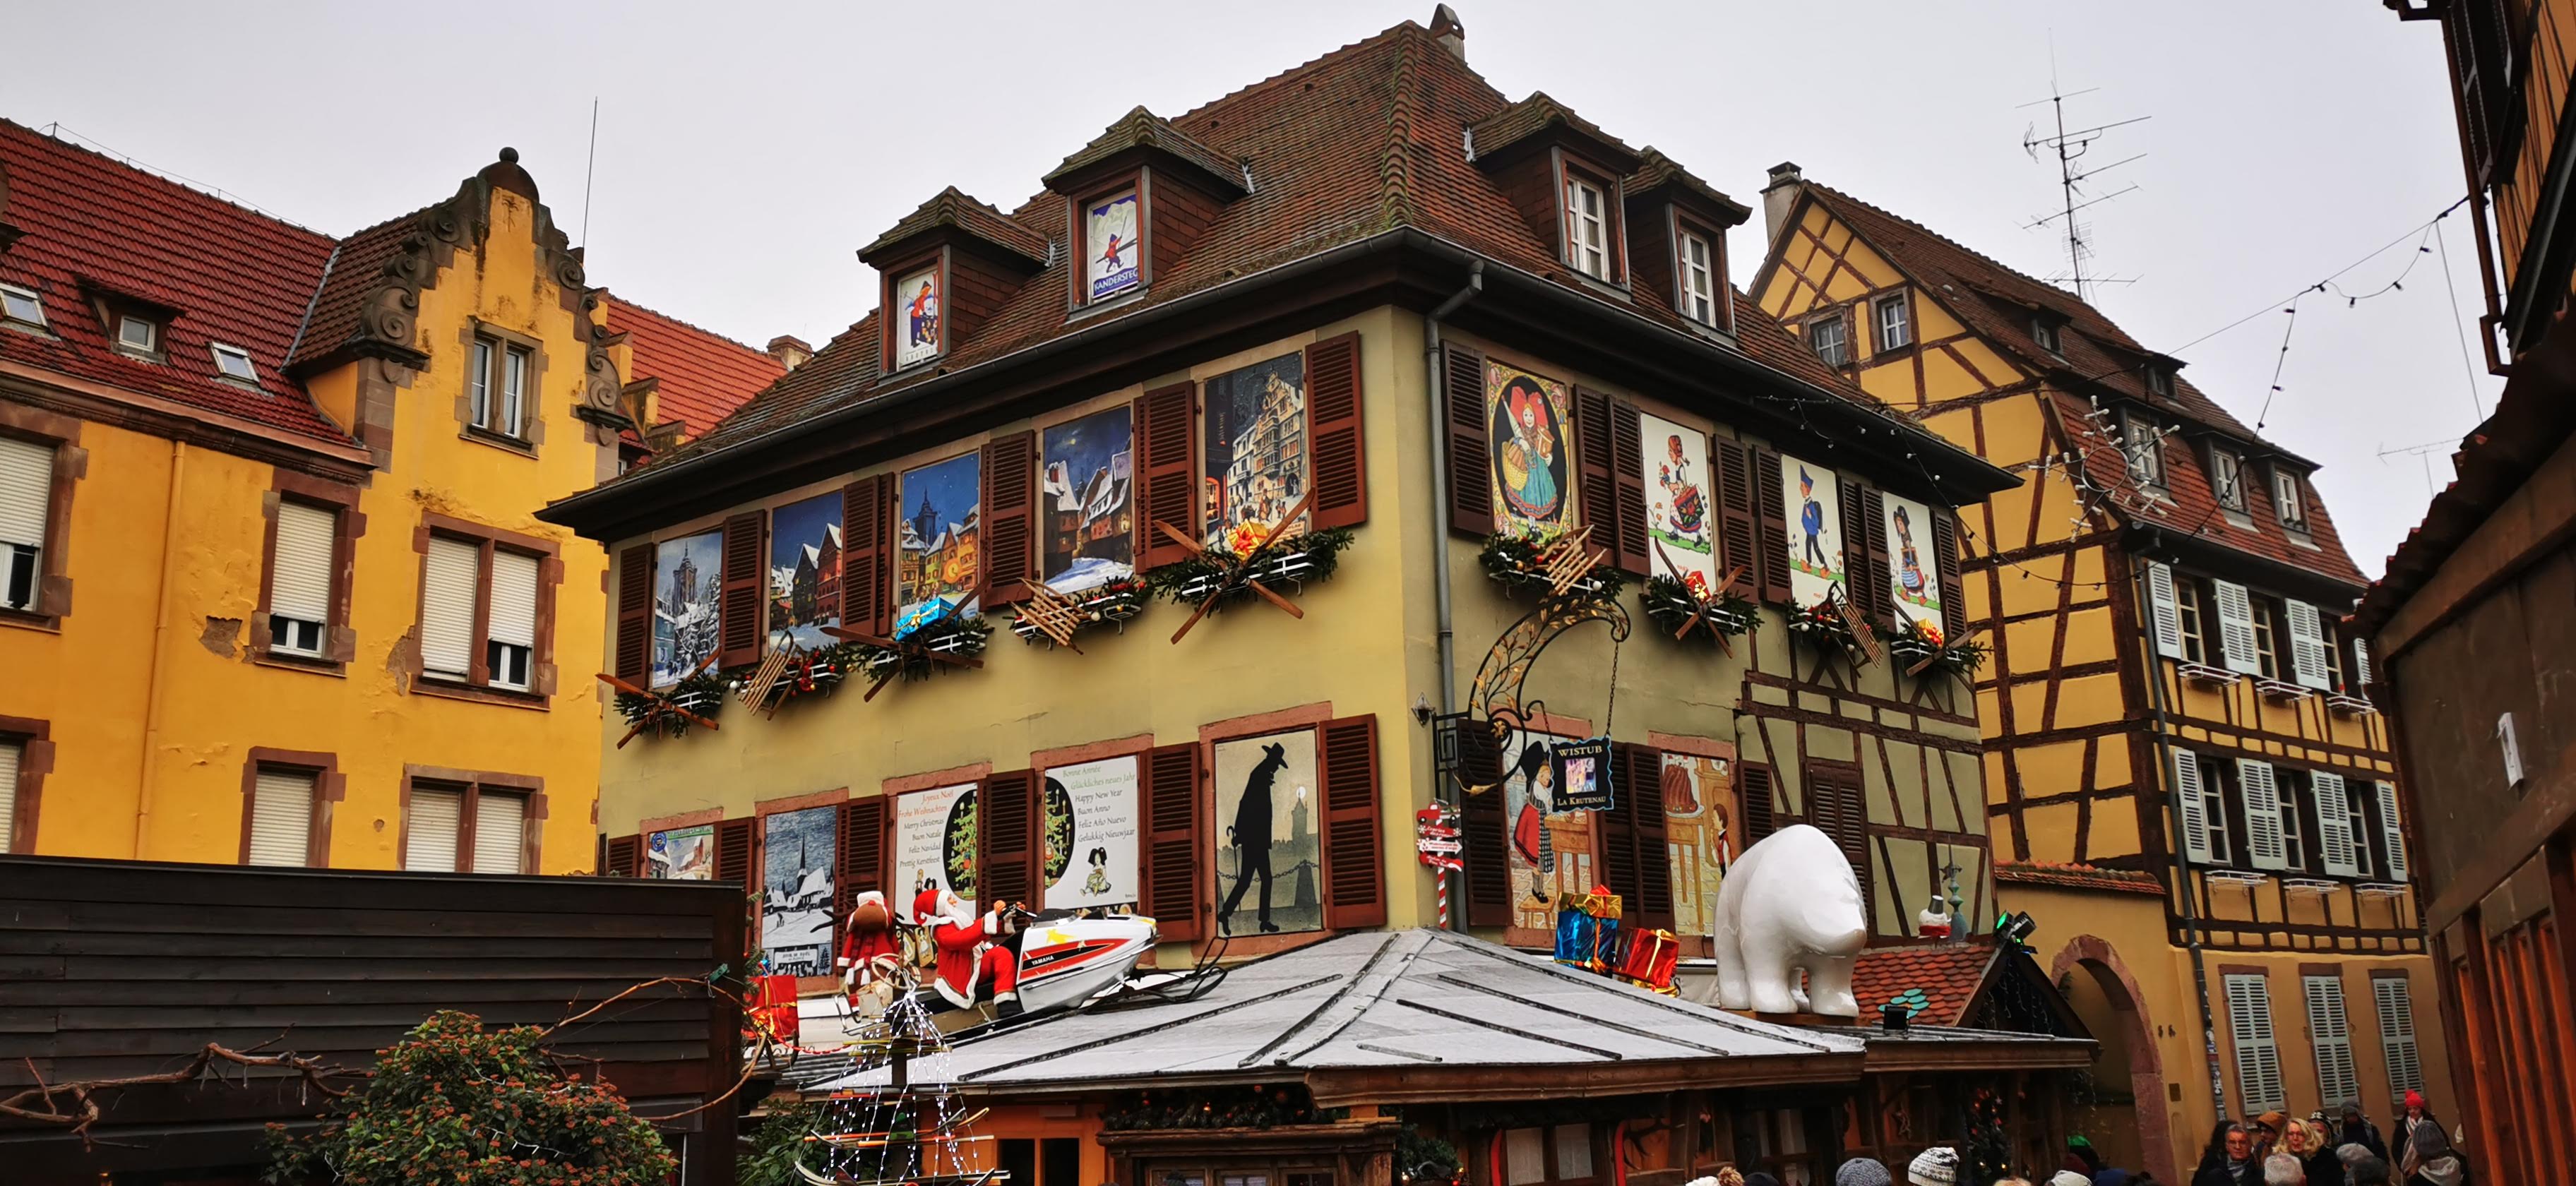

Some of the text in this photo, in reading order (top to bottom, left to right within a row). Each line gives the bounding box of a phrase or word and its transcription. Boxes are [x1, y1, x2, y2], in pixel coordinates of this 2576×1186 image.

[1094, 268, 1138, 292] KANDERSTEG
[1558, 745, 1602, 757] WISTUB
[1071, 778, 1104, 789] Glückliches
[1123, 772, 1135, 784] Jahr
[1075, 795, 1094, 804] Happy
[1078, 819, 1092, 829] Feliz
[1107, 816, 1126, 825] Nuevo
[909, 842, 941, 853] Feliz Navidad
[1031, 955, 1054, 966] YAMAHA
